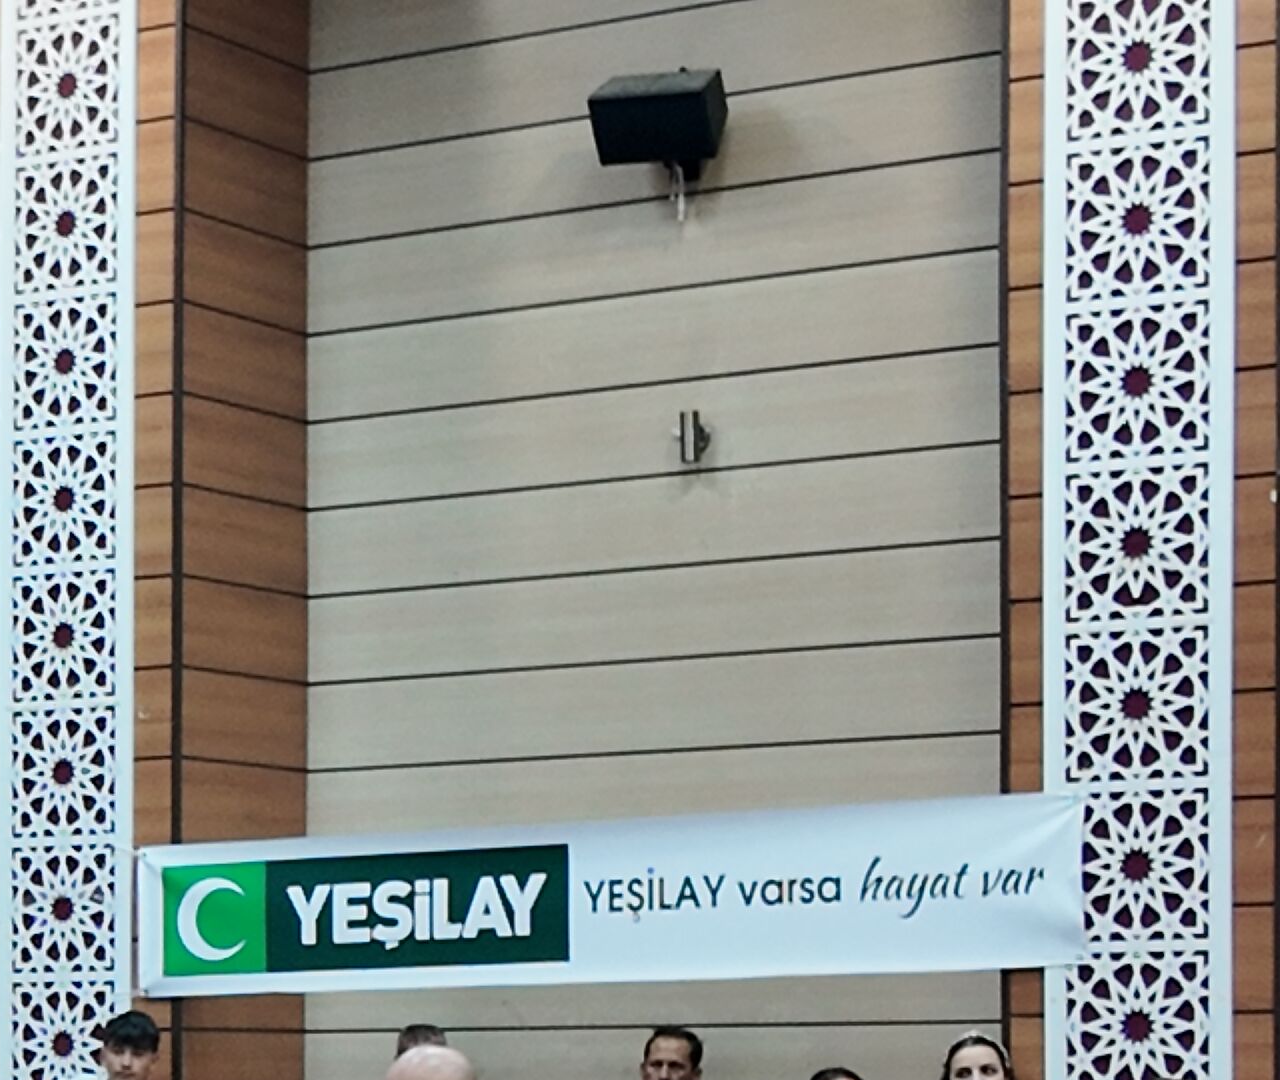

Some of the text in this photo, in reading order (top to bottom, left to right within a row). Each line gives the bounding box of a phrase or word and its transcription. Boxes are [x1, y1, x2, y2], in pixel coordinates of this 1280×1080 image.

[583, 856, 1045, 922] YEŞİLAY varsa hayat var
